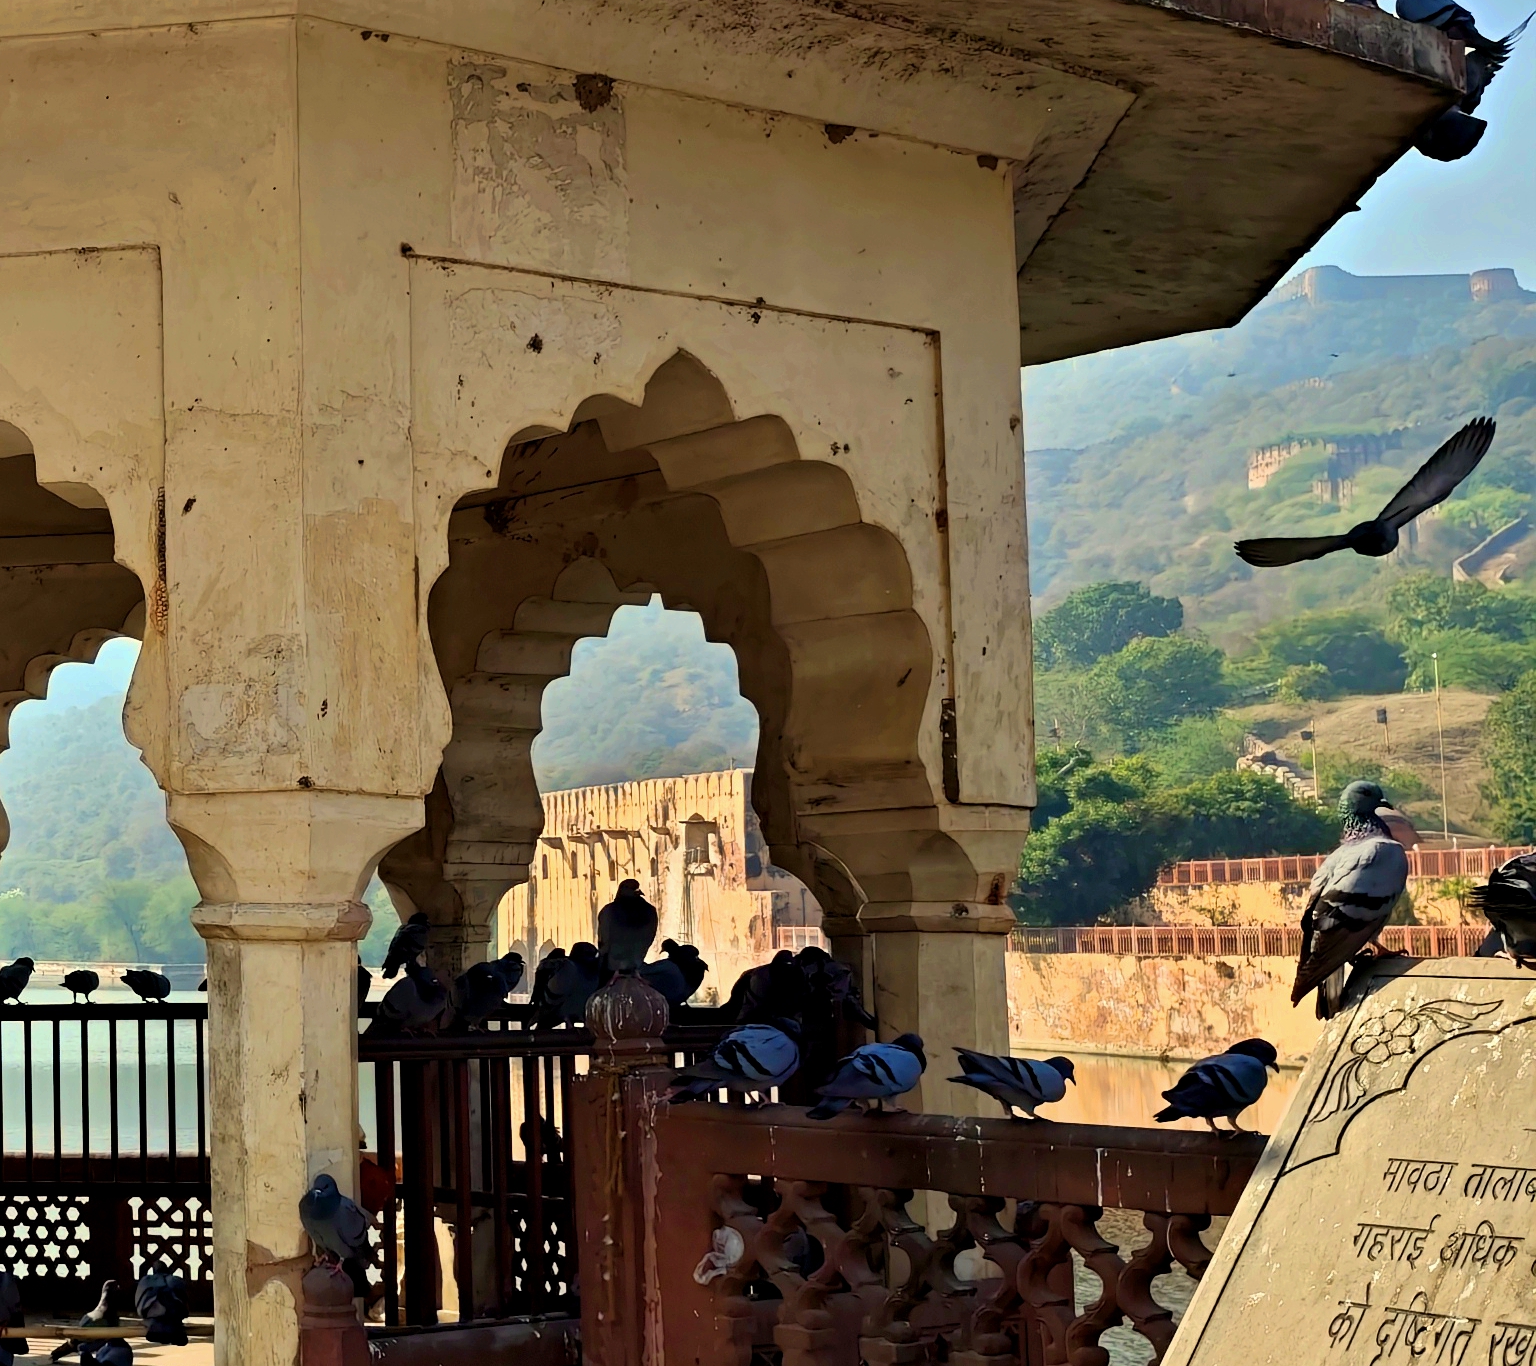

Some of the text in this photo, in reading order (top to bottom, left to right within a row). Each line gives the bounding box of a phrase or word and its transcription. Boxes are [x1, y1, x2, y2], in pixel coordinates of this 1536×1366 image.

[1383, 1158, 1459, 1196] मावठा
[1353, 1214, 1526, 1273] गहराई अधिक
[1328, 1281, 1372, 1351] को
